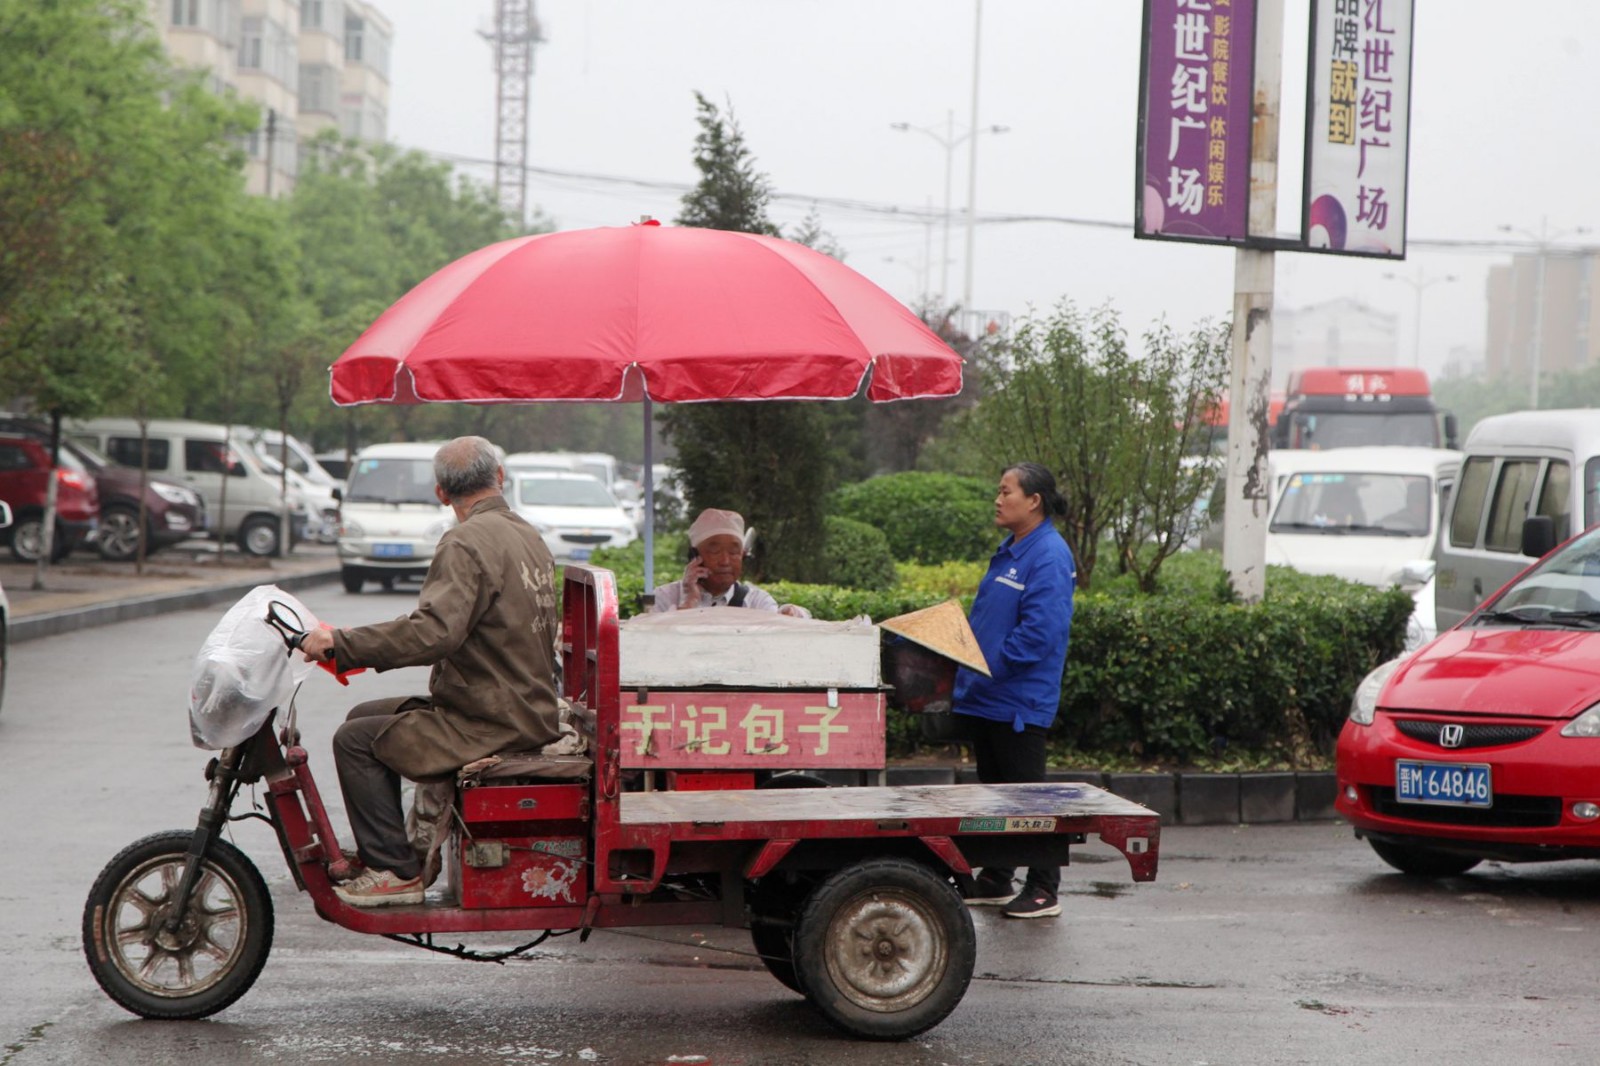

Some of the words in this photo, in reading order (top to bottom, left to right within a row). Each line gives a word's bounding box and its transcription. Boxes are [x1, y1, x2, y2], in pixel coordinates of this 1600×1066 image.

[1211, 14, 1230, 105] 影院餐饮
[1167, 0, 1211, 215] 世纪广场
[1208, 116, 1226, 206] 休闲娱乐
